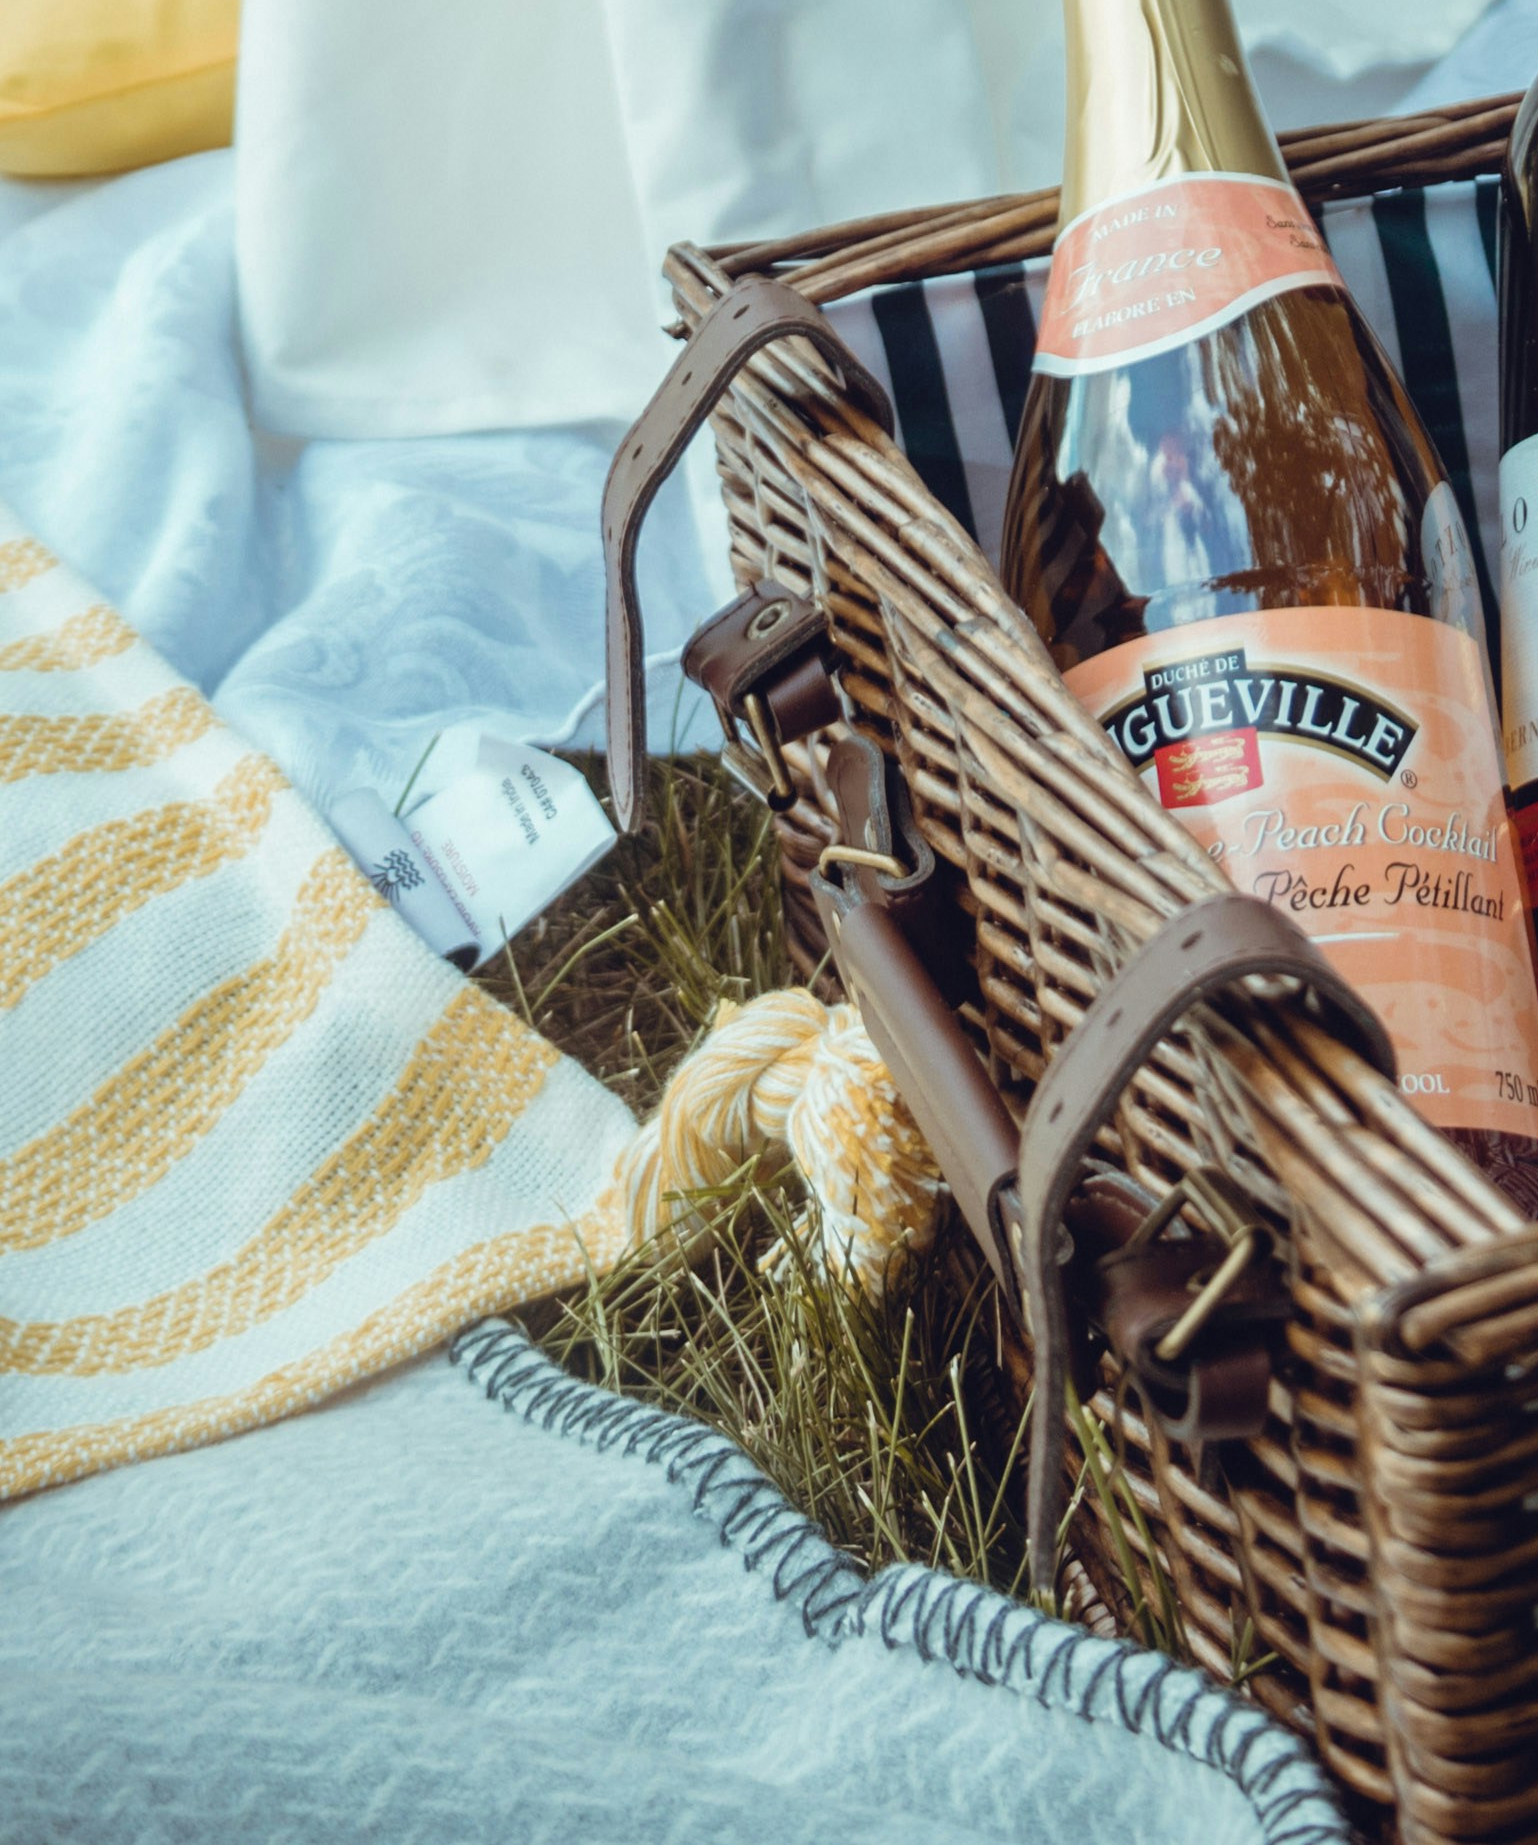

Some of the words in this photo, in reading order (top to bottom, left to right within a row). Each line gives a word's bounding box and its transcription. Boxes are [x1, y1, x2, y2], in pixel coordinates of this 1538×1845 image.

[1091, 207, 1149, 244] MADE
[1155, 202, 1179, 219] IN
[1060, 245, 1224, 315] France
[1166, 286, 1197, 310] EN
[1150, 658, 1211, 691] DUCHÉ
[1215, 653, 1241, 673] DE
[500, 777, 520, 808] India
[518, 813, 541, 846] Made
[1377, 803, 1498, 864] Cocktail
[440, 838, 480, 897] MOISTURE
[1252, 863, 1372, 912] Pêche
[1383, 861, 1505, 922] Pétillant
[1400, 1073, 1451, 1095] OOL
[1495, 1070, 1524, 1104] 750
